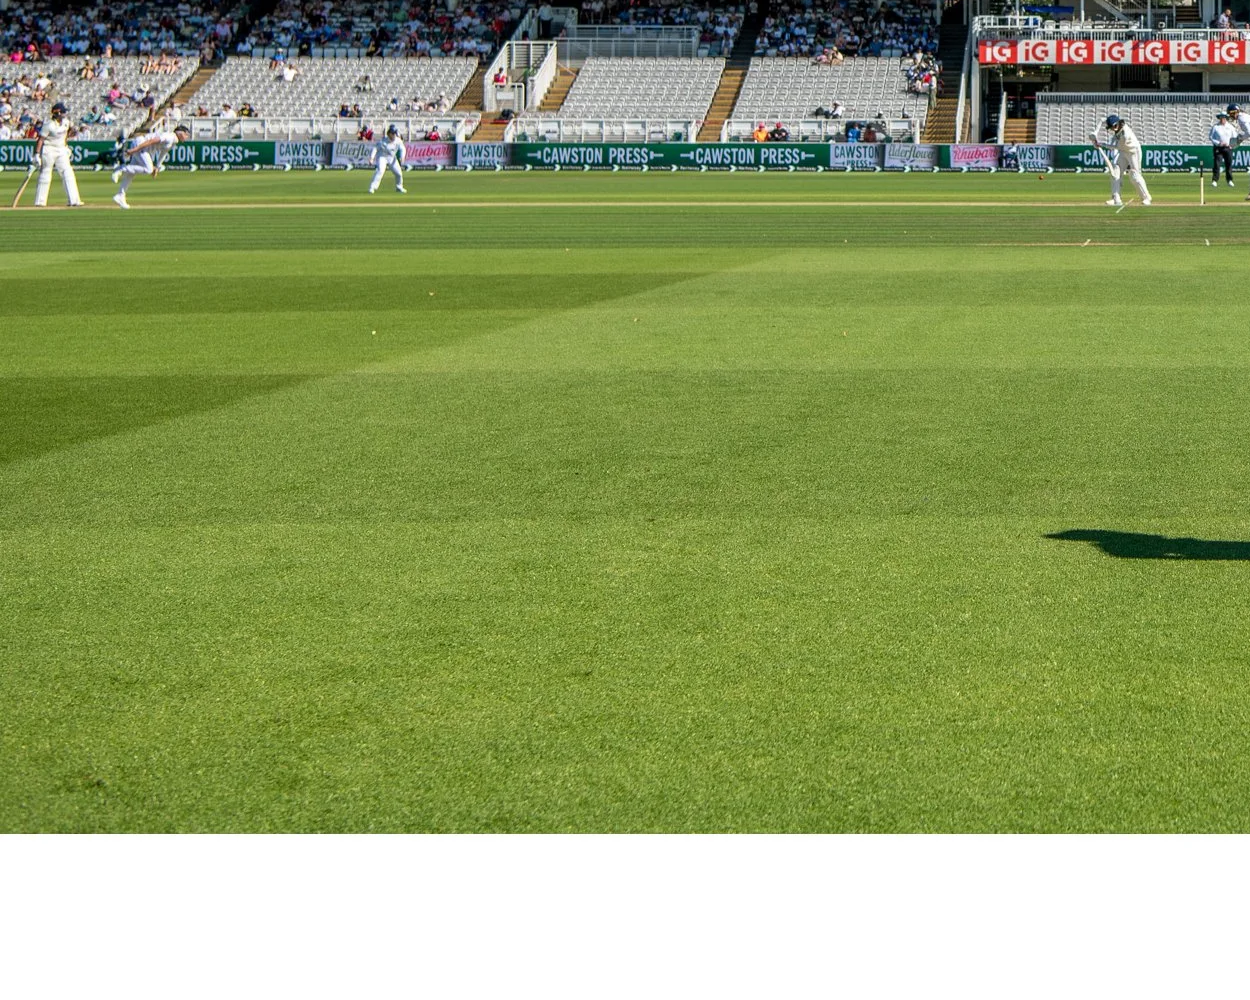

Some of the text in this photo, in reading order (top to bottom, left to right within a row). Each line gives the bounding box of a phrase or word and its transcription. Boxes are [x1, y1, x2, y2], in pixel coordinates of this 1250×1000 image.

[202, 146, 243, 162] PRESS
[279, 144, 326, 156] CAWSTON
[462, 144, 508, 157] CAWSTON
[542, 147, 648, 164] CAWSTON PRESS
[696, 148, 799, 164] CAWSTON PRESS
[834, 146, 880, 158] CAWSTON
[1146, 150, 1183, 166] PRESS
